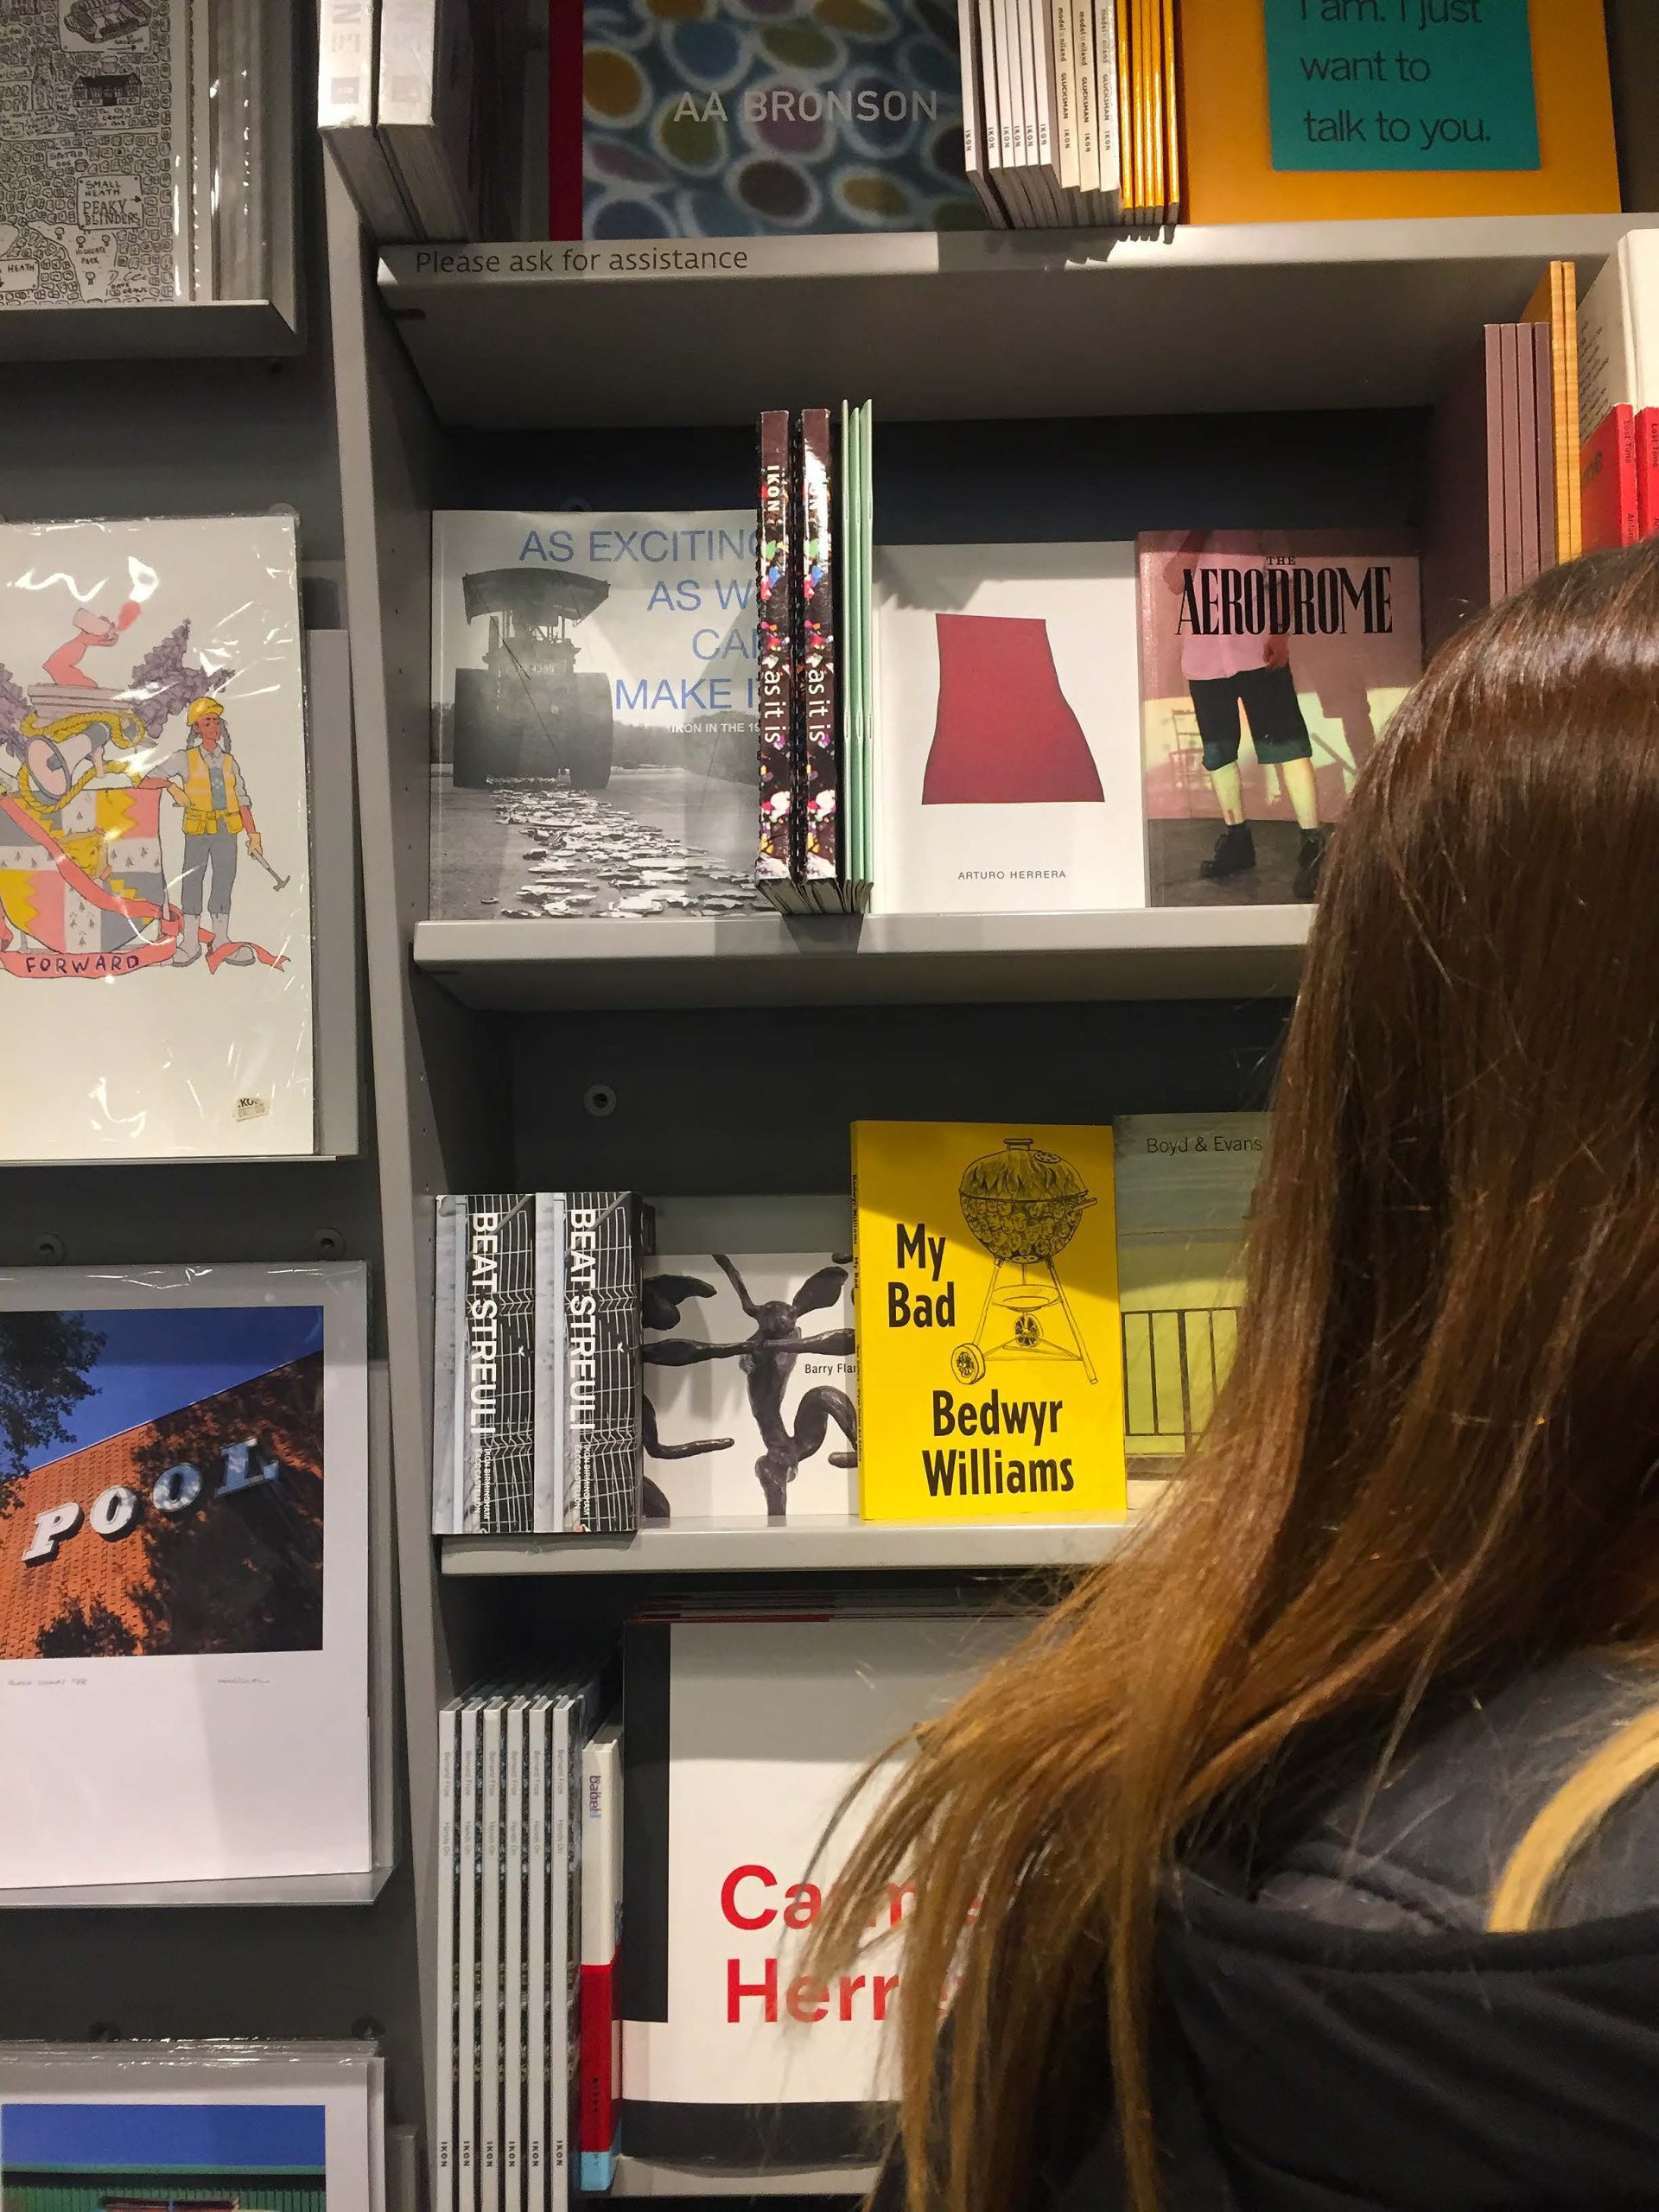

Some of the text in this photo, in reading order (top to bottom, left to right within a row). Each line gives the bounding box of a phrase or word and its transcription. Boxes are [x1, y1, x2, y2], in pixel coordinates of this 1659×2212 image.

[1321, 0, 1386, 22] am.
[1417, 0, 1483, 31] just
[1300, 50, 1431, 81] want to
[673, 91, 937, 122] AA BRONSON
[1303, 110, 1491, 150] talk to you.
[82, 199, 127, 215] PEAKY
[416, 247, 747, 273] Please ask for assistance
[767, 465, 779, 512] IKON
[519, 531, 575, 562] AS
[1266, 556, 1296, 565] THE
[647, 579, 754, 611] AS W
[1174, 567, 1393, 635] AERODROME
[615, 678, 733, 710] MAKE
[765, 671, 787, 743] as it is
[808, 670, 830, 741] as it is
[671, 723, 702, 733] IKON
[705, 723, 717, 733] IN
[721, 723, 745, 733] THE
[958, 870, 1066, 880] ARTURO HERRERA
[26, 955, 138, 973] FORWARD
[1147, 1136, 1262, 1156] Boyd & Evans
[896, 1224, 946, 1281] My
[569, 1209, 595, 1430] BEAT STREULI
[888, 1281, 955, 1328] Bad
[470, 1212, 498, 1433] BEAT STREULI
[805, 1363, 833, 1376] Barry
[932, 1389, 1063, 1446] Bedwyr
[922, 1449, 1075, 1497] Williams
[22, 1438, 279, 1565] POOL
